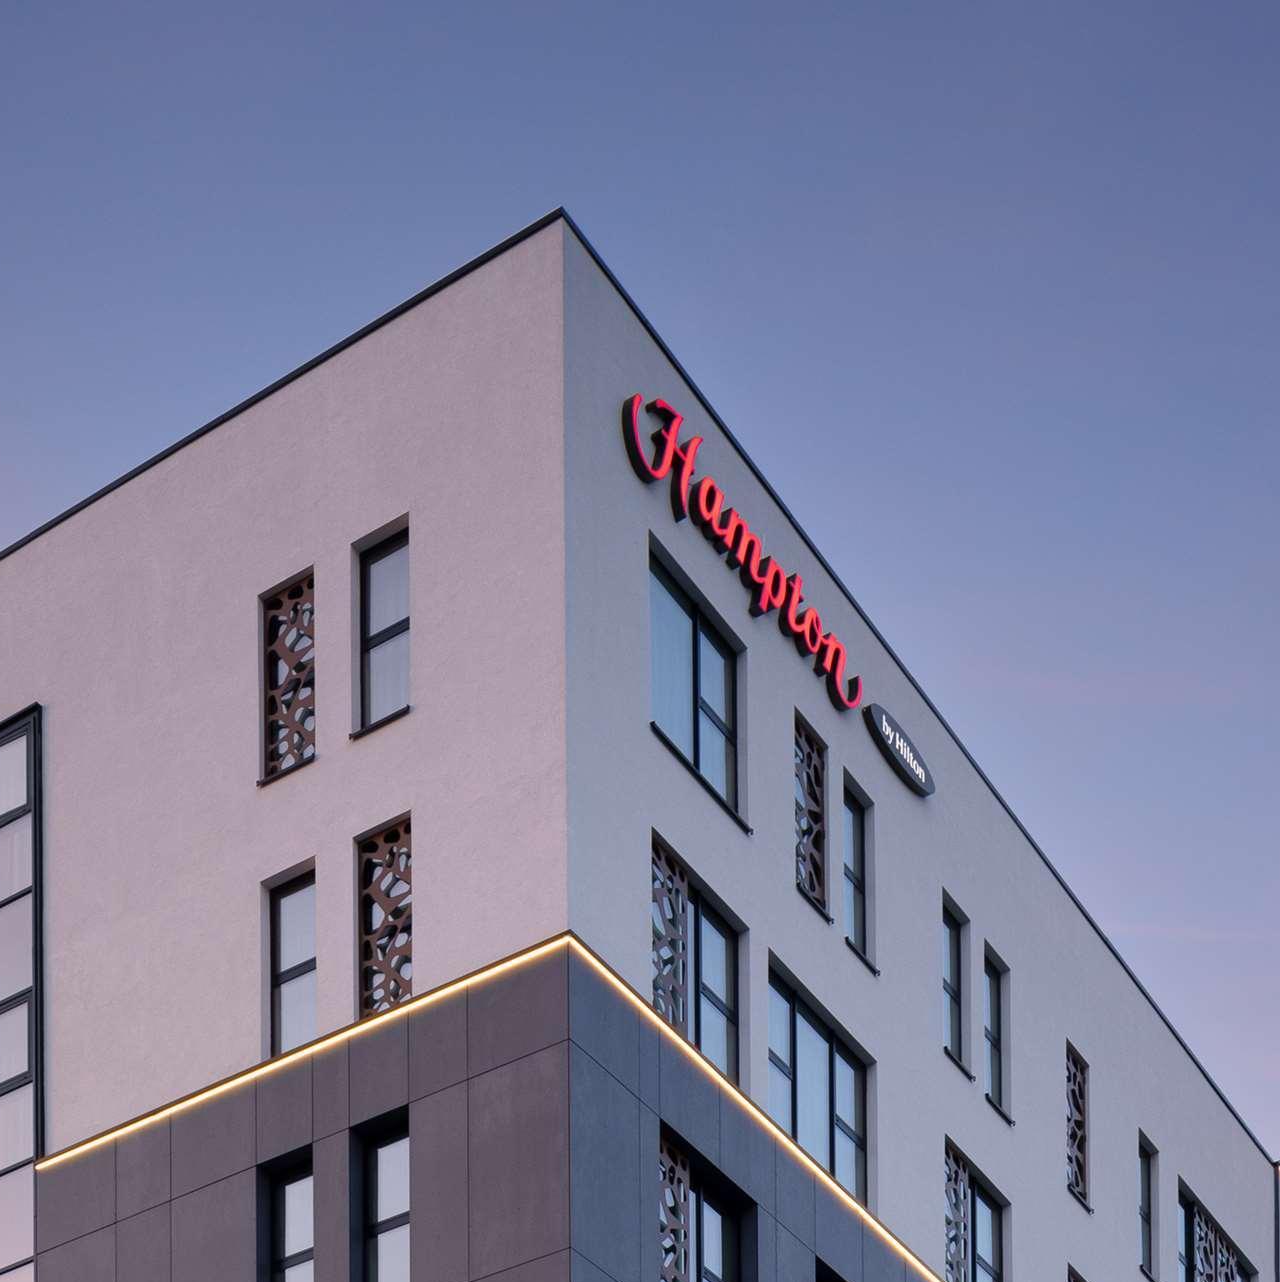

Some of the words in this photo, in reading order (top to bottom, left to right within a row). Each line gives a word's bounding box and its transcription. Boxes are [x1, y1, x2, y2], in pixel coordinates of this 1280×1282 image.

[624, 393, 862, 710] Hampton
[882, 714, 894, 744] by
[895, 733, 925, 783] Hilton
